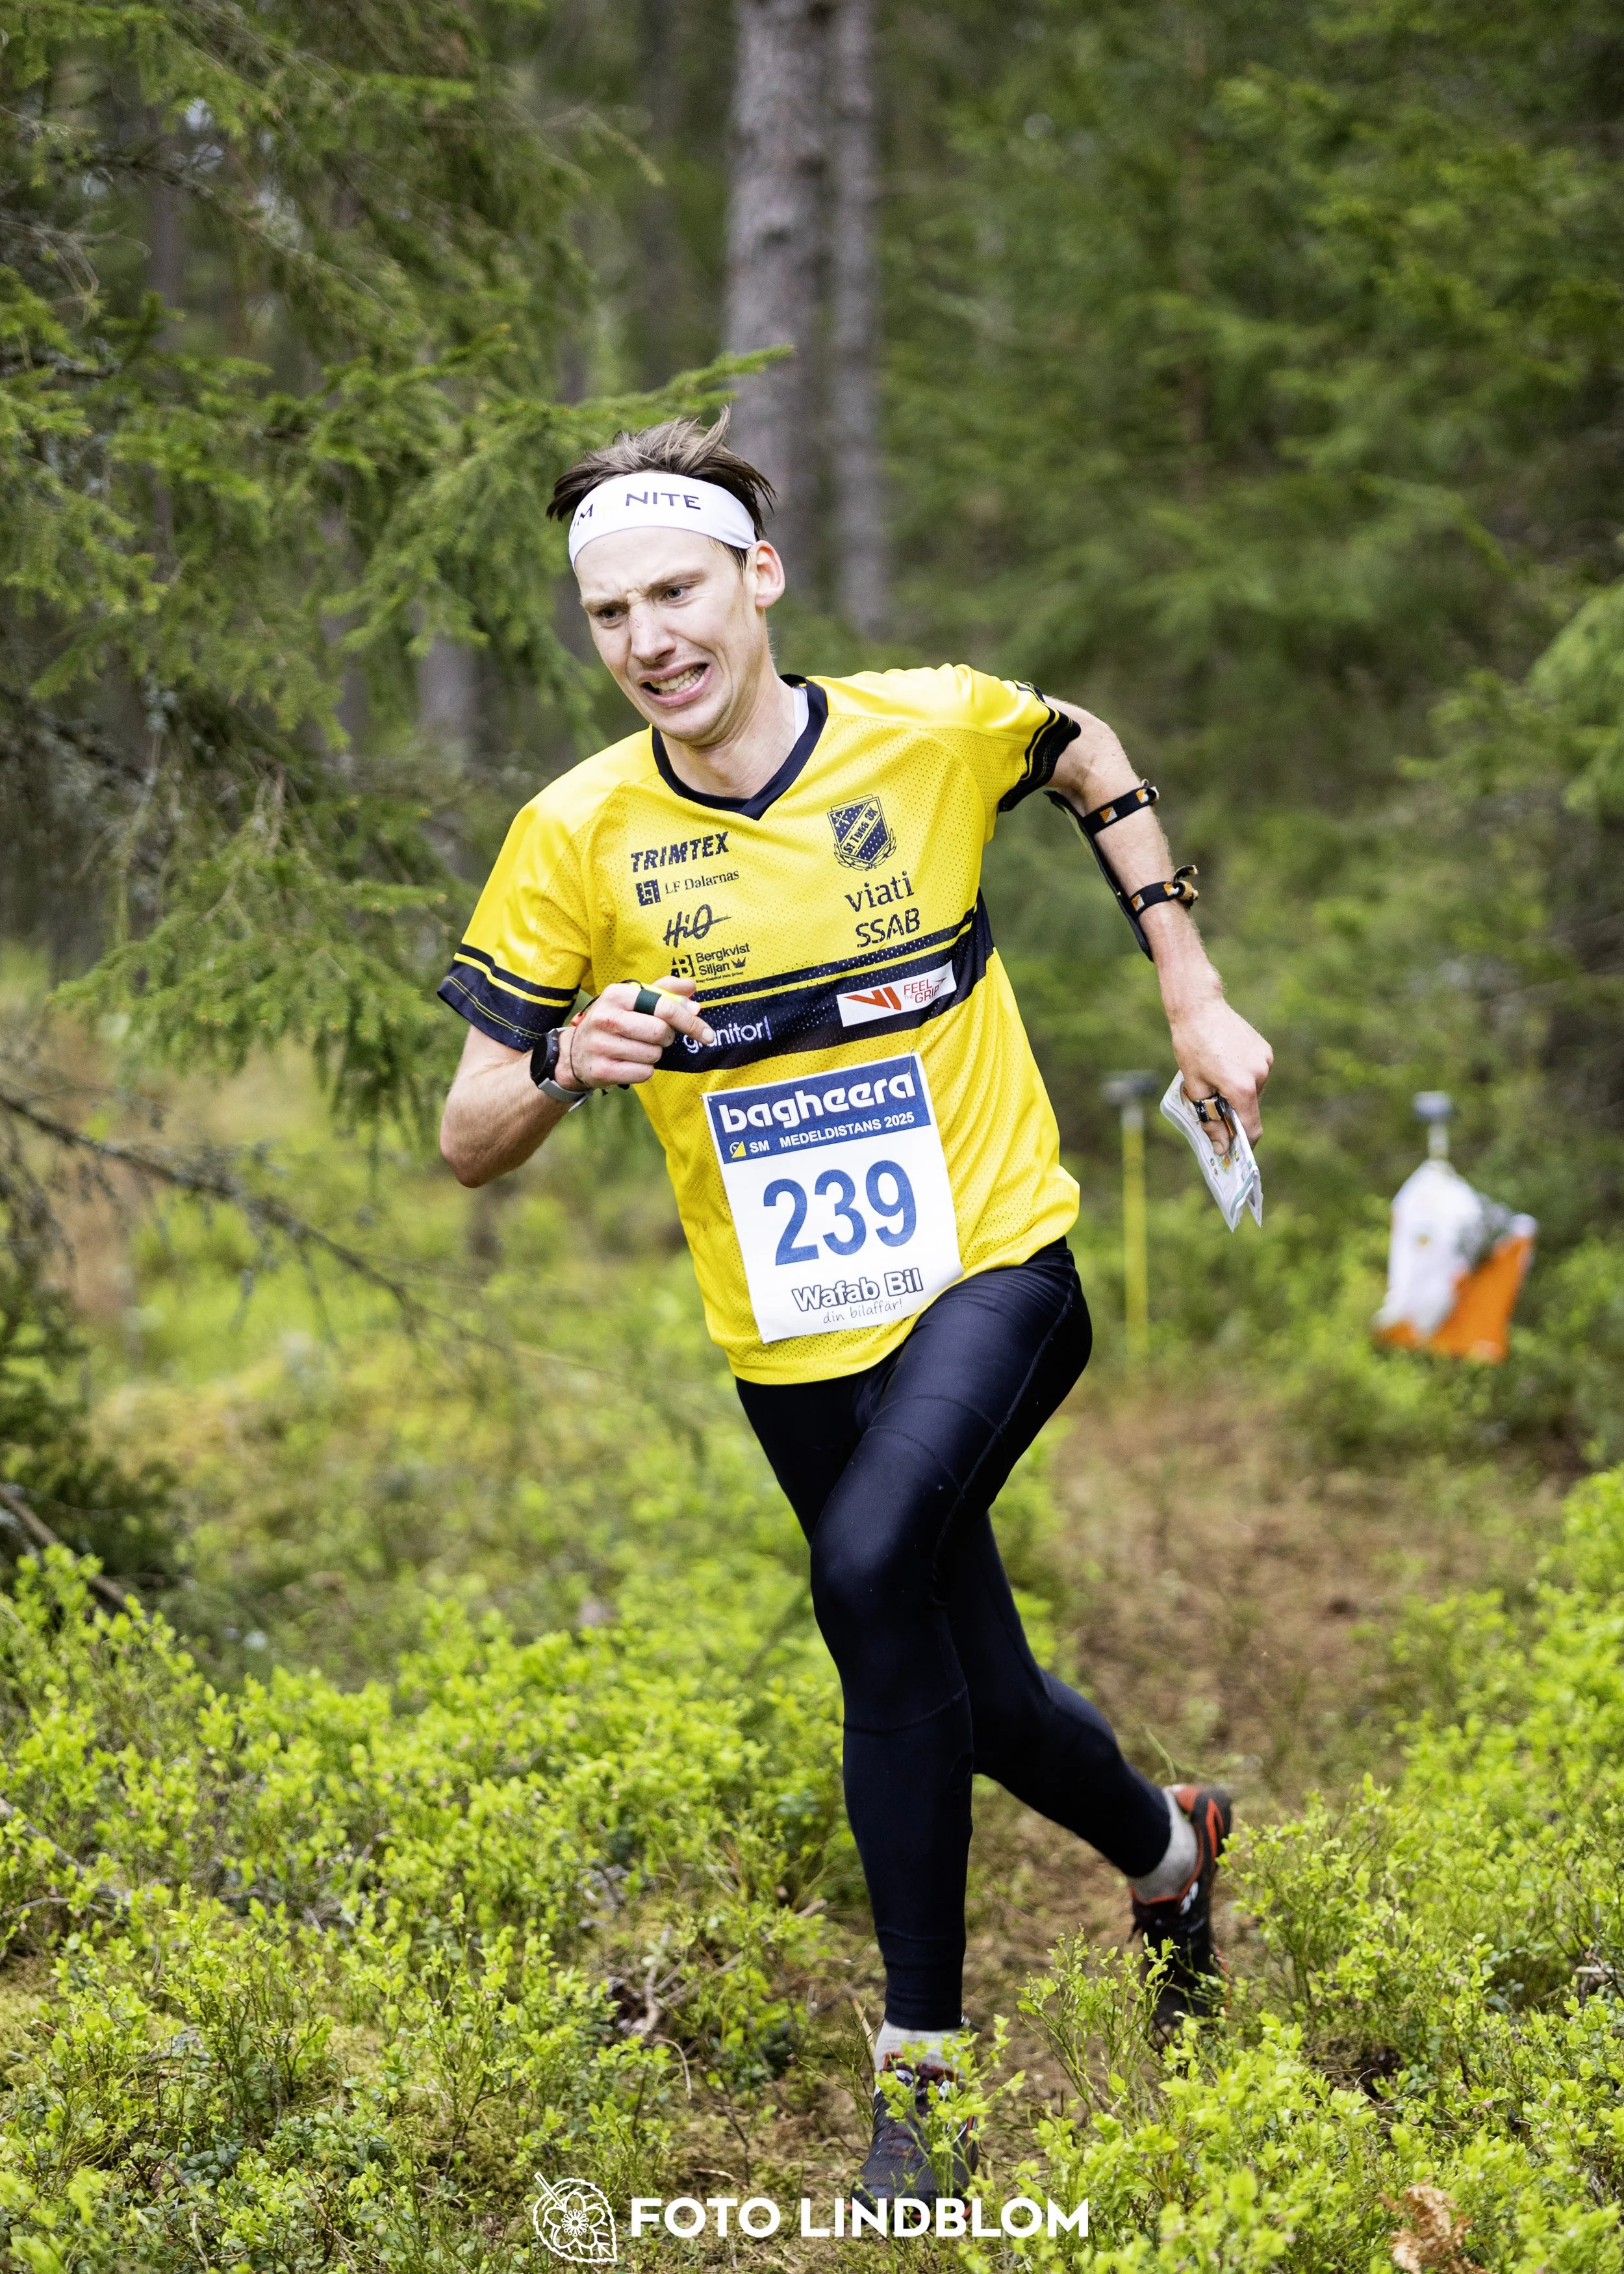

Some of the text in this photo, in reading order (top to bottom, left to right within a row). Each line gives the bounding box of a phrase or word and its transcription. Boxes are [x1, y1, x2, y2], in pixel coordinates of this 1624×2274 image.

[626, 492, 701, 510] NITE
[631, 831, 729, 873] TRIMTEX
[665, 871, 740, 895] LF Dalarnas
[844, 871, 915, 912] viati
[855, 907, 920, 948] SSAB
[695, 943, 751, 963] Bergkvist
[698, 962, 730, 975] Siljan
[904, 978, 932, 995] FEEL
[915, 984, 939, 1003] GRIP
[683, 1022, 763, 1053] gnitor
[718, 1073, 915, 1133] bagheera
[749, 1111, 915, 1154] SM MEDELDISTANS 2025
[763, 1160, 917, 1266] 239
[791, 1268, 924, 1312] Wafab Bil
[823, 1298, 904, 1324] din bilaffär!
